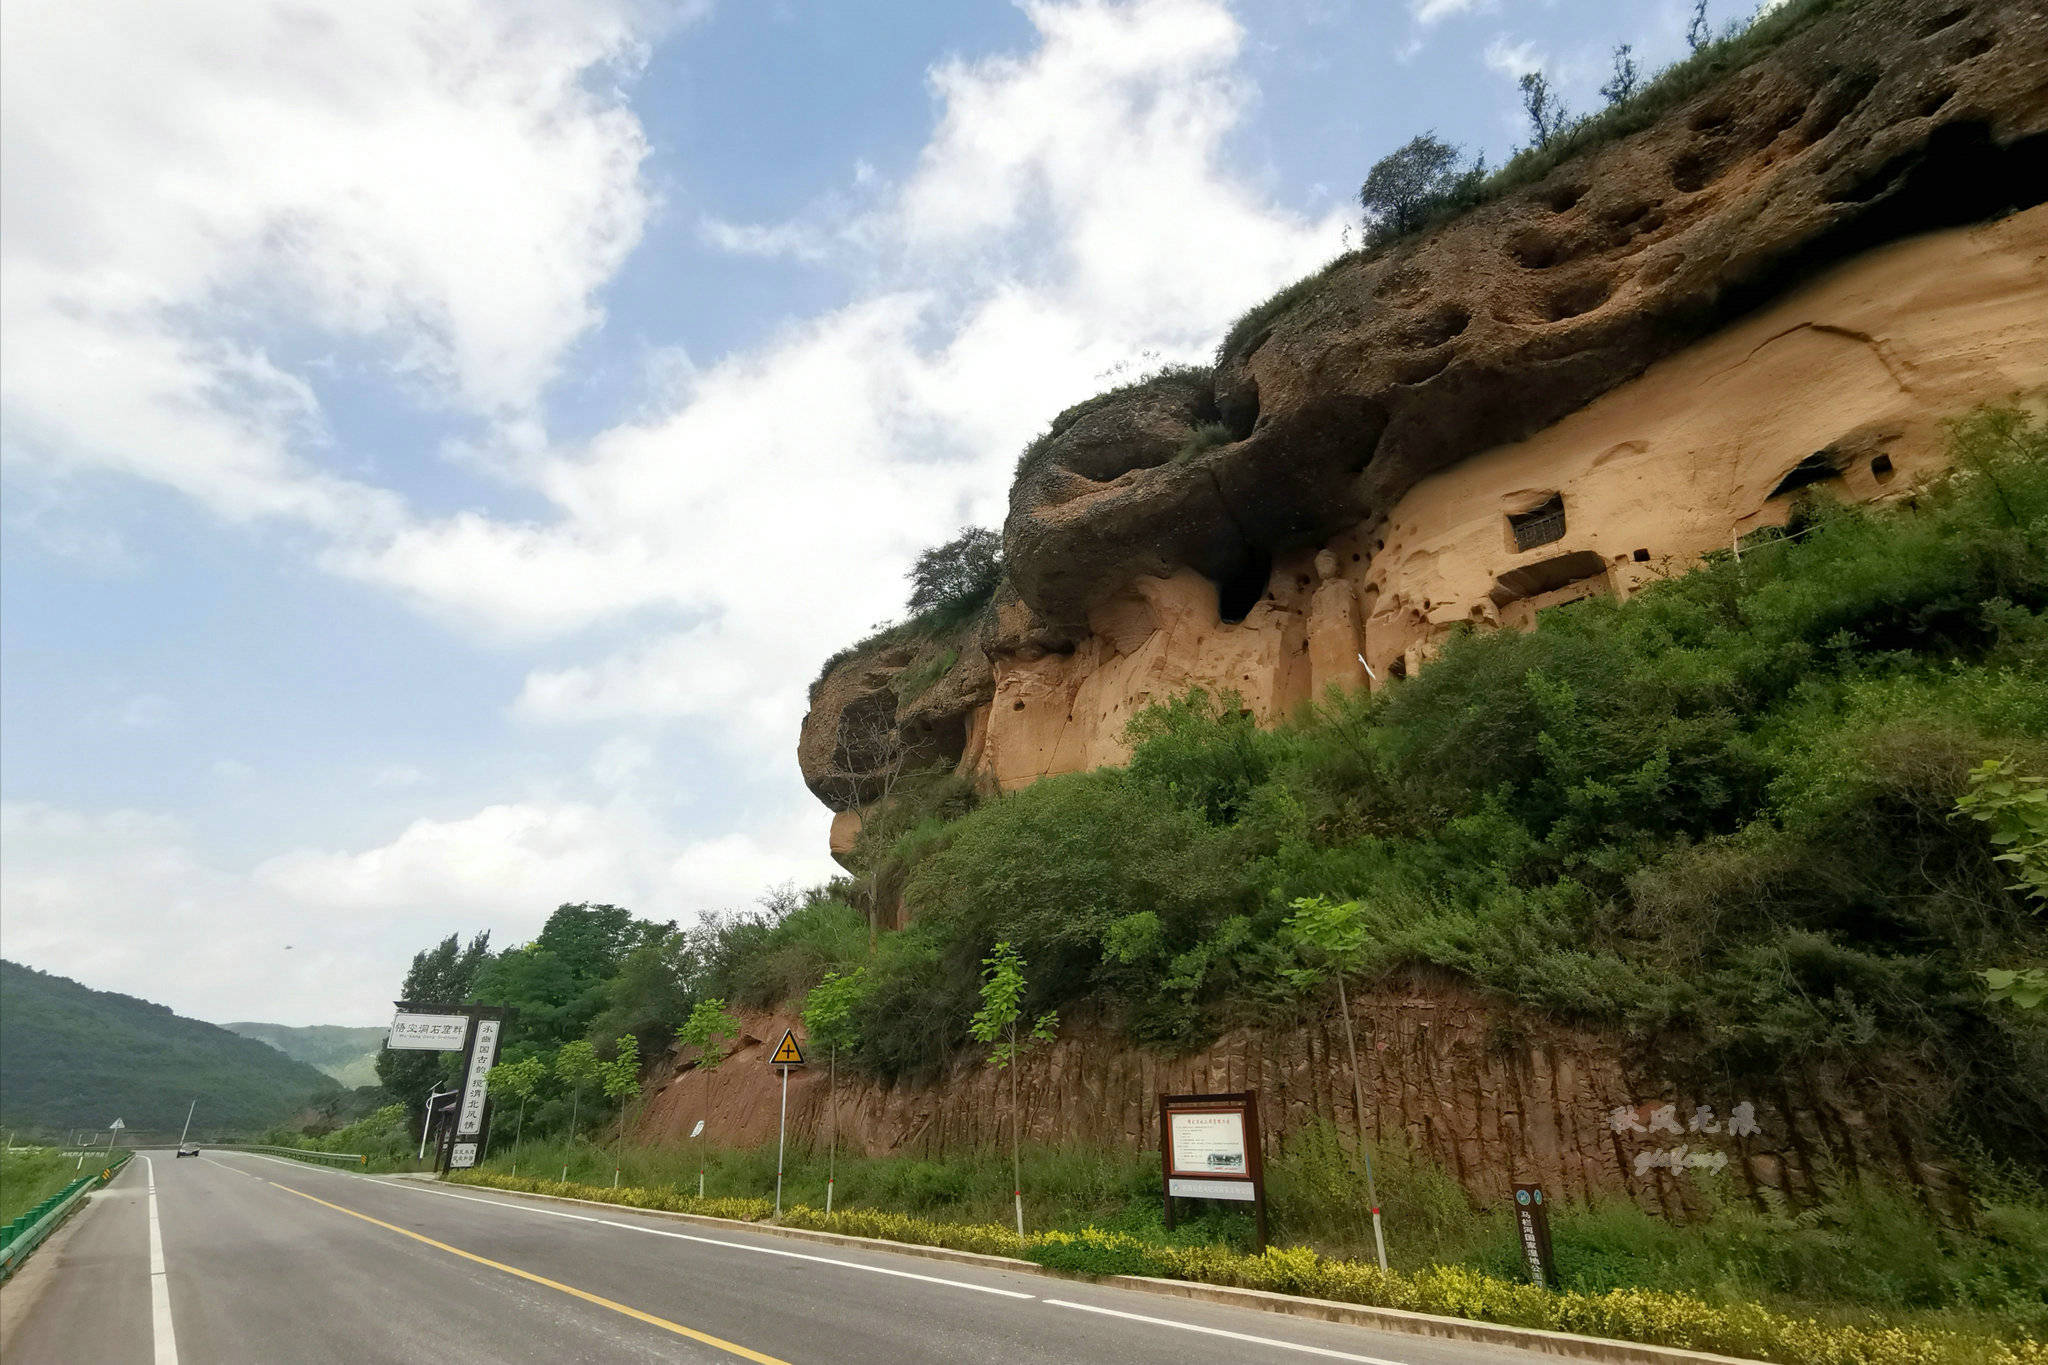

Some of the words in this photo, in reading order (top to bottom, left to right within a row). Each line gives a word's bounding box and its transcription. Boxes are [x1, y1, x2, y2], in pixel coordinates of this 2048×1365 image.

[395, 1022, 463, 1035] 悟空洞石窟群
